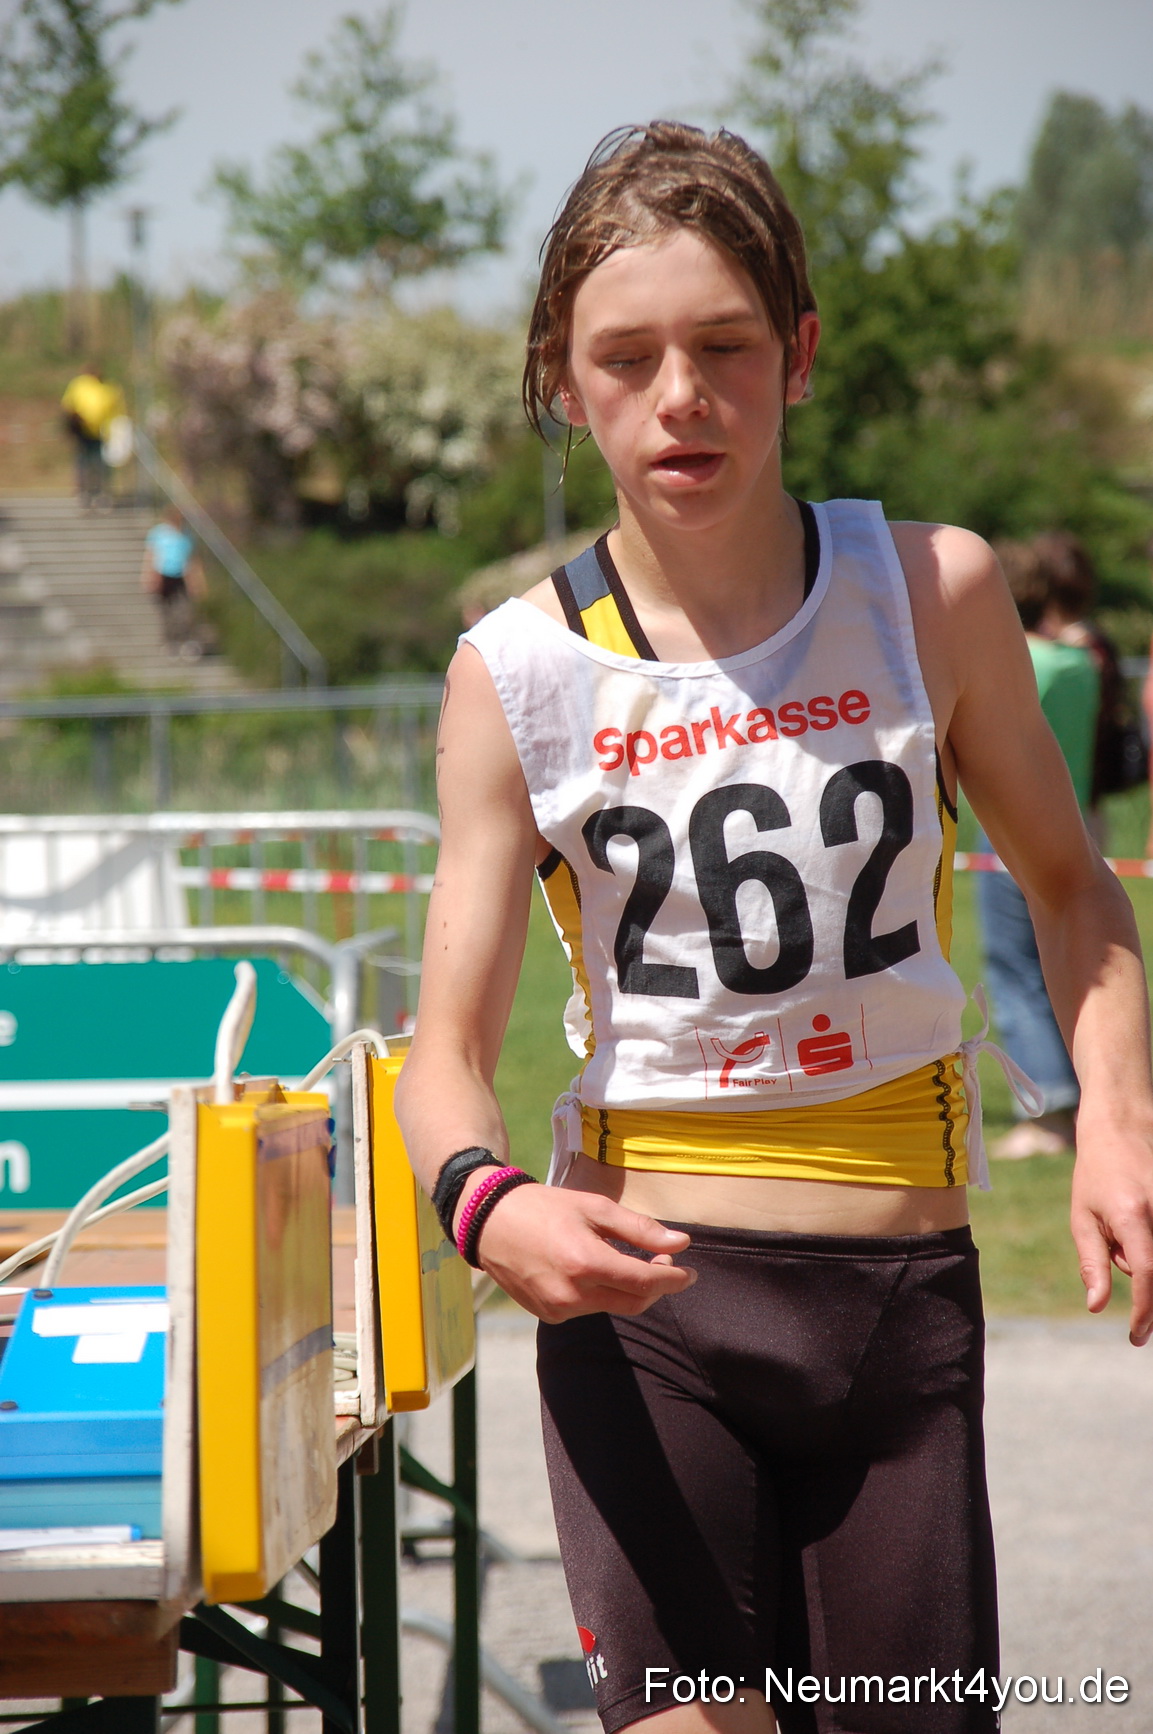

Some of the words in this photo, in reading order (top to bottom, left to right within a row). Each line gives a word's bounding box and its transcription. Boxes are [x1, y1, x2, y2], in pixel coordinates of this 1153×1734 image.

[593, 690, 870, 776] sparkasse
[581, 760, 921, 999] 262
[732, 1078, 752, 1088] Fair
[754, 1078, 778, 1086] Play
